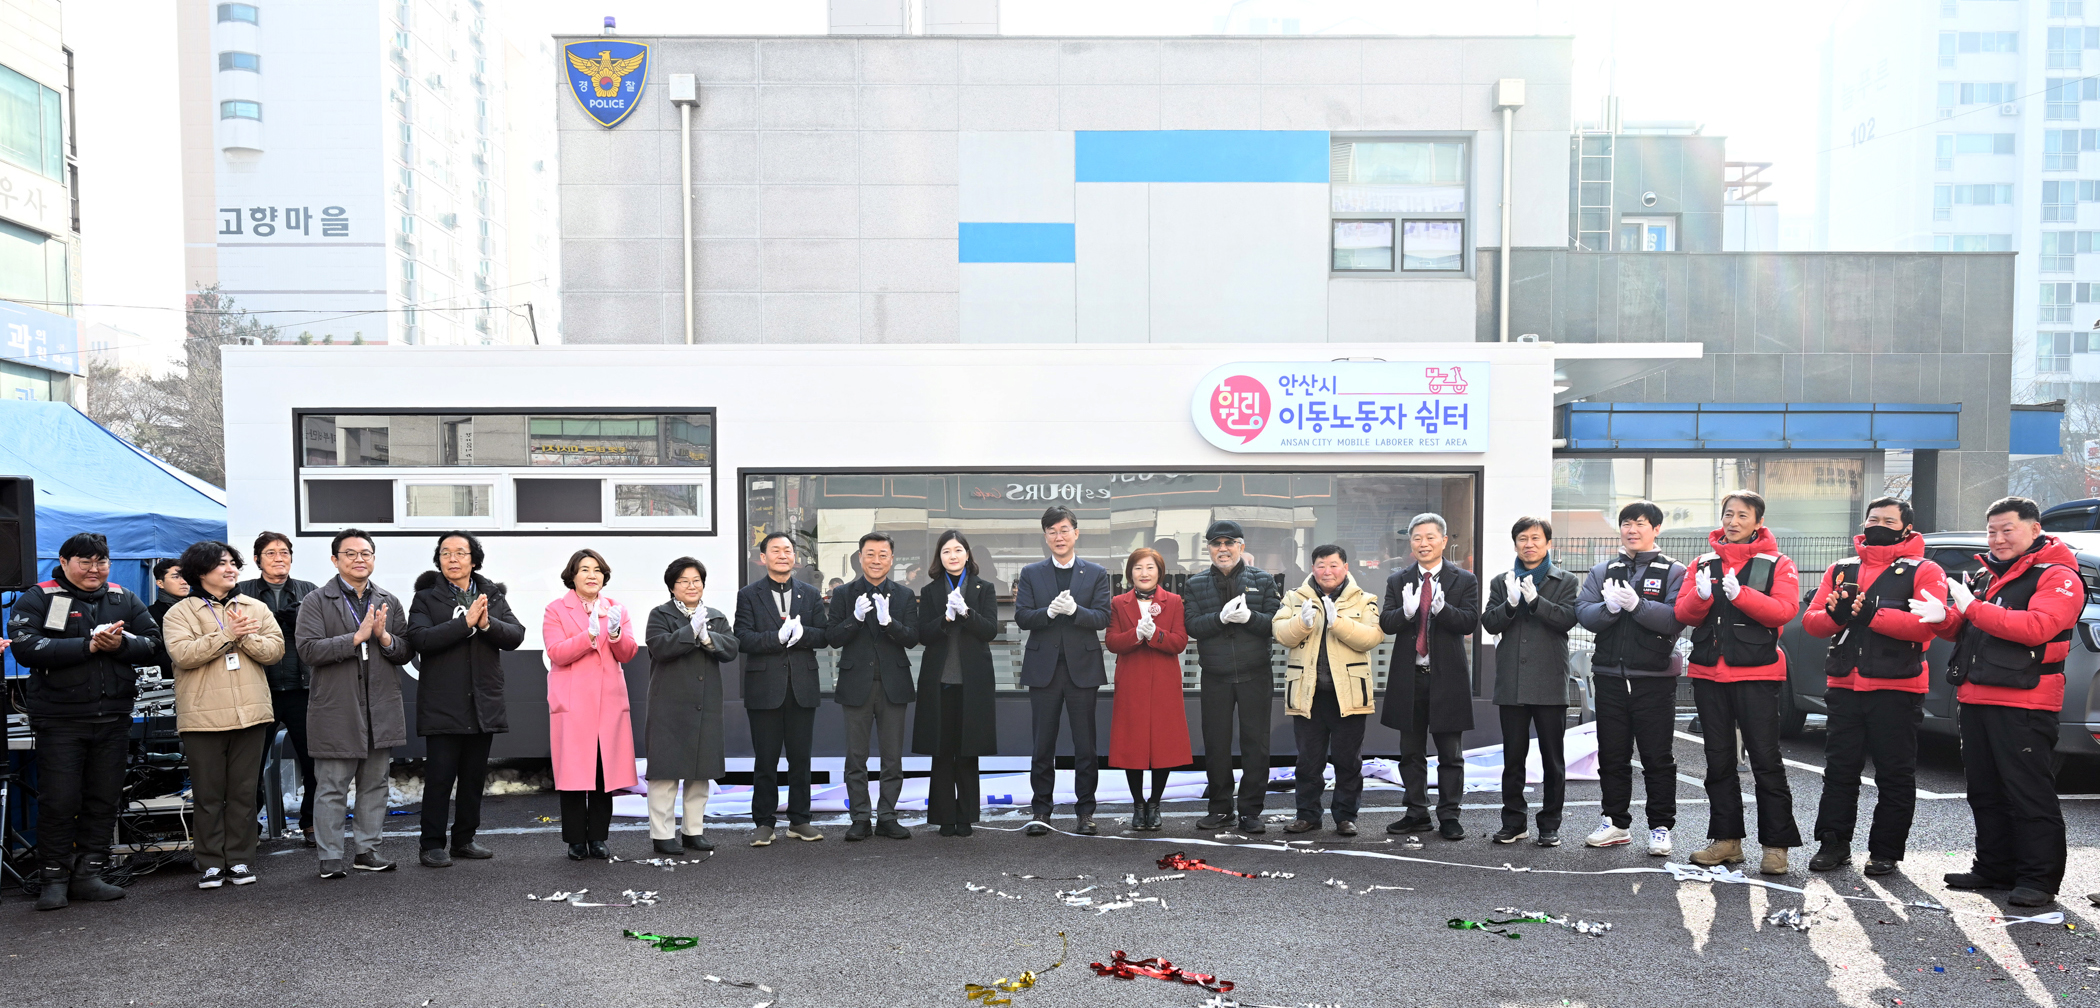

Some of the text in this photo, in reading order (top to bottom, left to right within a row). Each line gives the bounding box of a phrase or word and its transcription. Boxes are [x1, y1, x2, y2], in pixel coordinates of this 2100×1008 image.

[578, 80, 636, 93] 경 찰
[589, 99, 625, 109] POLICE
[1850, 117, 1875, 148] 102
[218, 205, 350, 238] 고향마을
[1278, 373, 1337, 396] 안산시
[1278, 399, 1468, 434] 이동노동자 쉼터
[1280, 438, 1468, 447] ANSAN CITY MOBILE LABORER REST AREA
